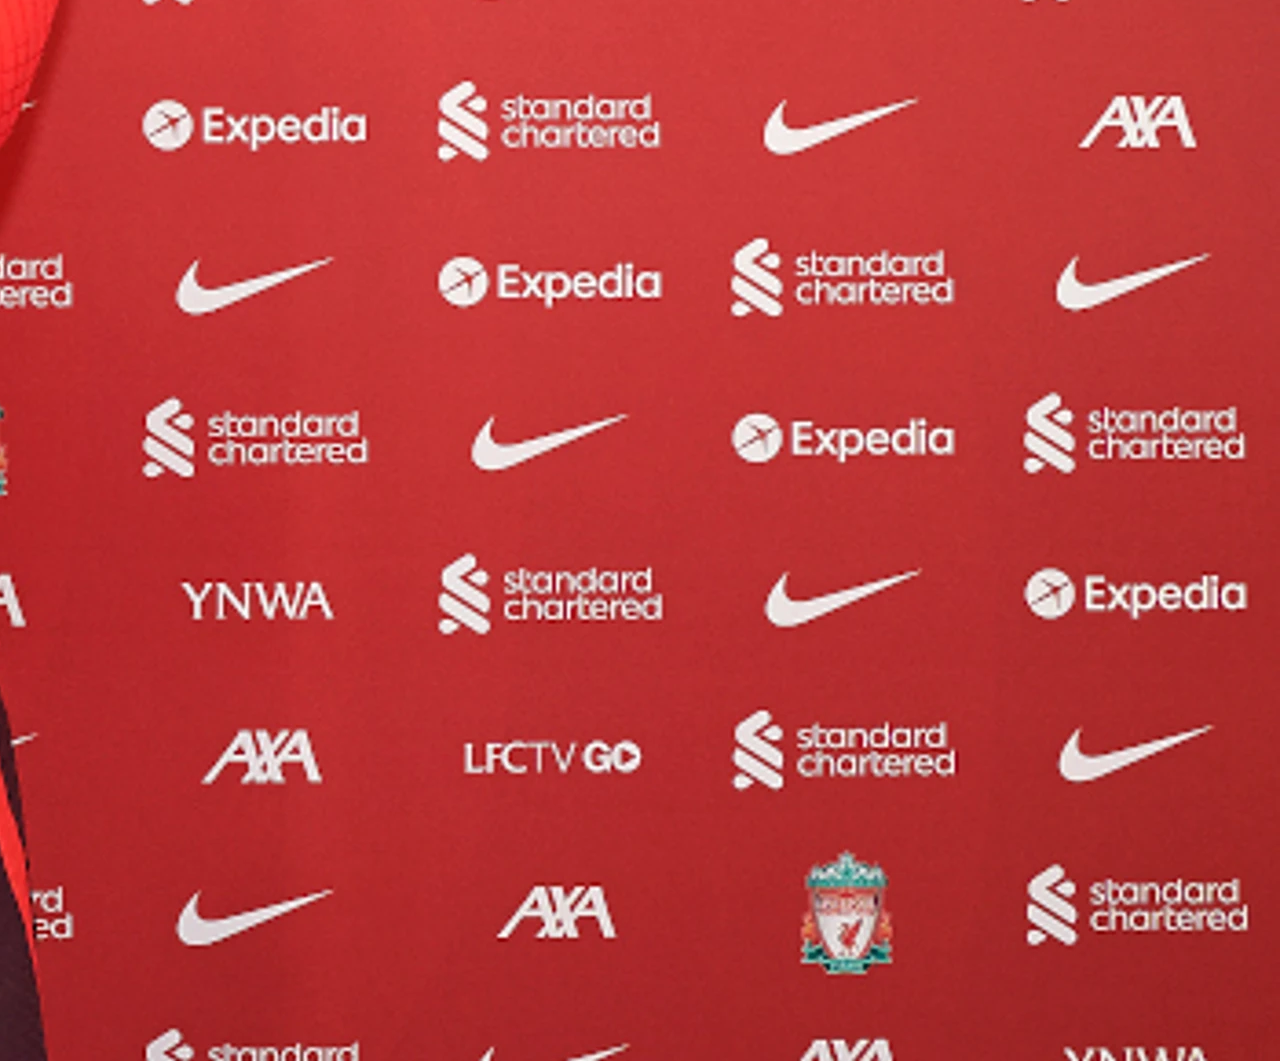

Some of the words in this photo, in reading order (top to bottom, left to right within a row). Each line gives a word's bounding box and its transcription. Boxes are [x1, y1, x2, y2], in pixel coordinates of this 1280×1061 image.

[501, 94, 651, 121] standard
[203, 107, 366, 151] Expedia
[501, 121, 660, 148] chartered
[1079, 96, 1196, 148] AXA
[796, 250, 944, 276] standard
[498, 263, 661, 308] Expedia
[796, 278, 954, 305] chartered
[208, 411, 358, 437] standard
[1089, 407, 1243, 434] standard
[208, 438, 367, 465] chartered
[792, 418, 954, 463] Expedia
[1088, 434, 1245, 459] chartered
[504, 567, 652, 594] standard
[182, 582, 333, 619] YNWA
[504, 594, 662, 620] chartered
[1085, 575, 1247, 619] Expedia
[797, 722, 946, 749] standard
[202, 729, 322, 784] AXA
[582, 740, 641, 773] GO
[797, 750, 955, 777] chartered
[1090, 879, 1247, 906] standard
[497, 886, 615, 938] AXA
[1090, 906, 1247, 930] chartered
